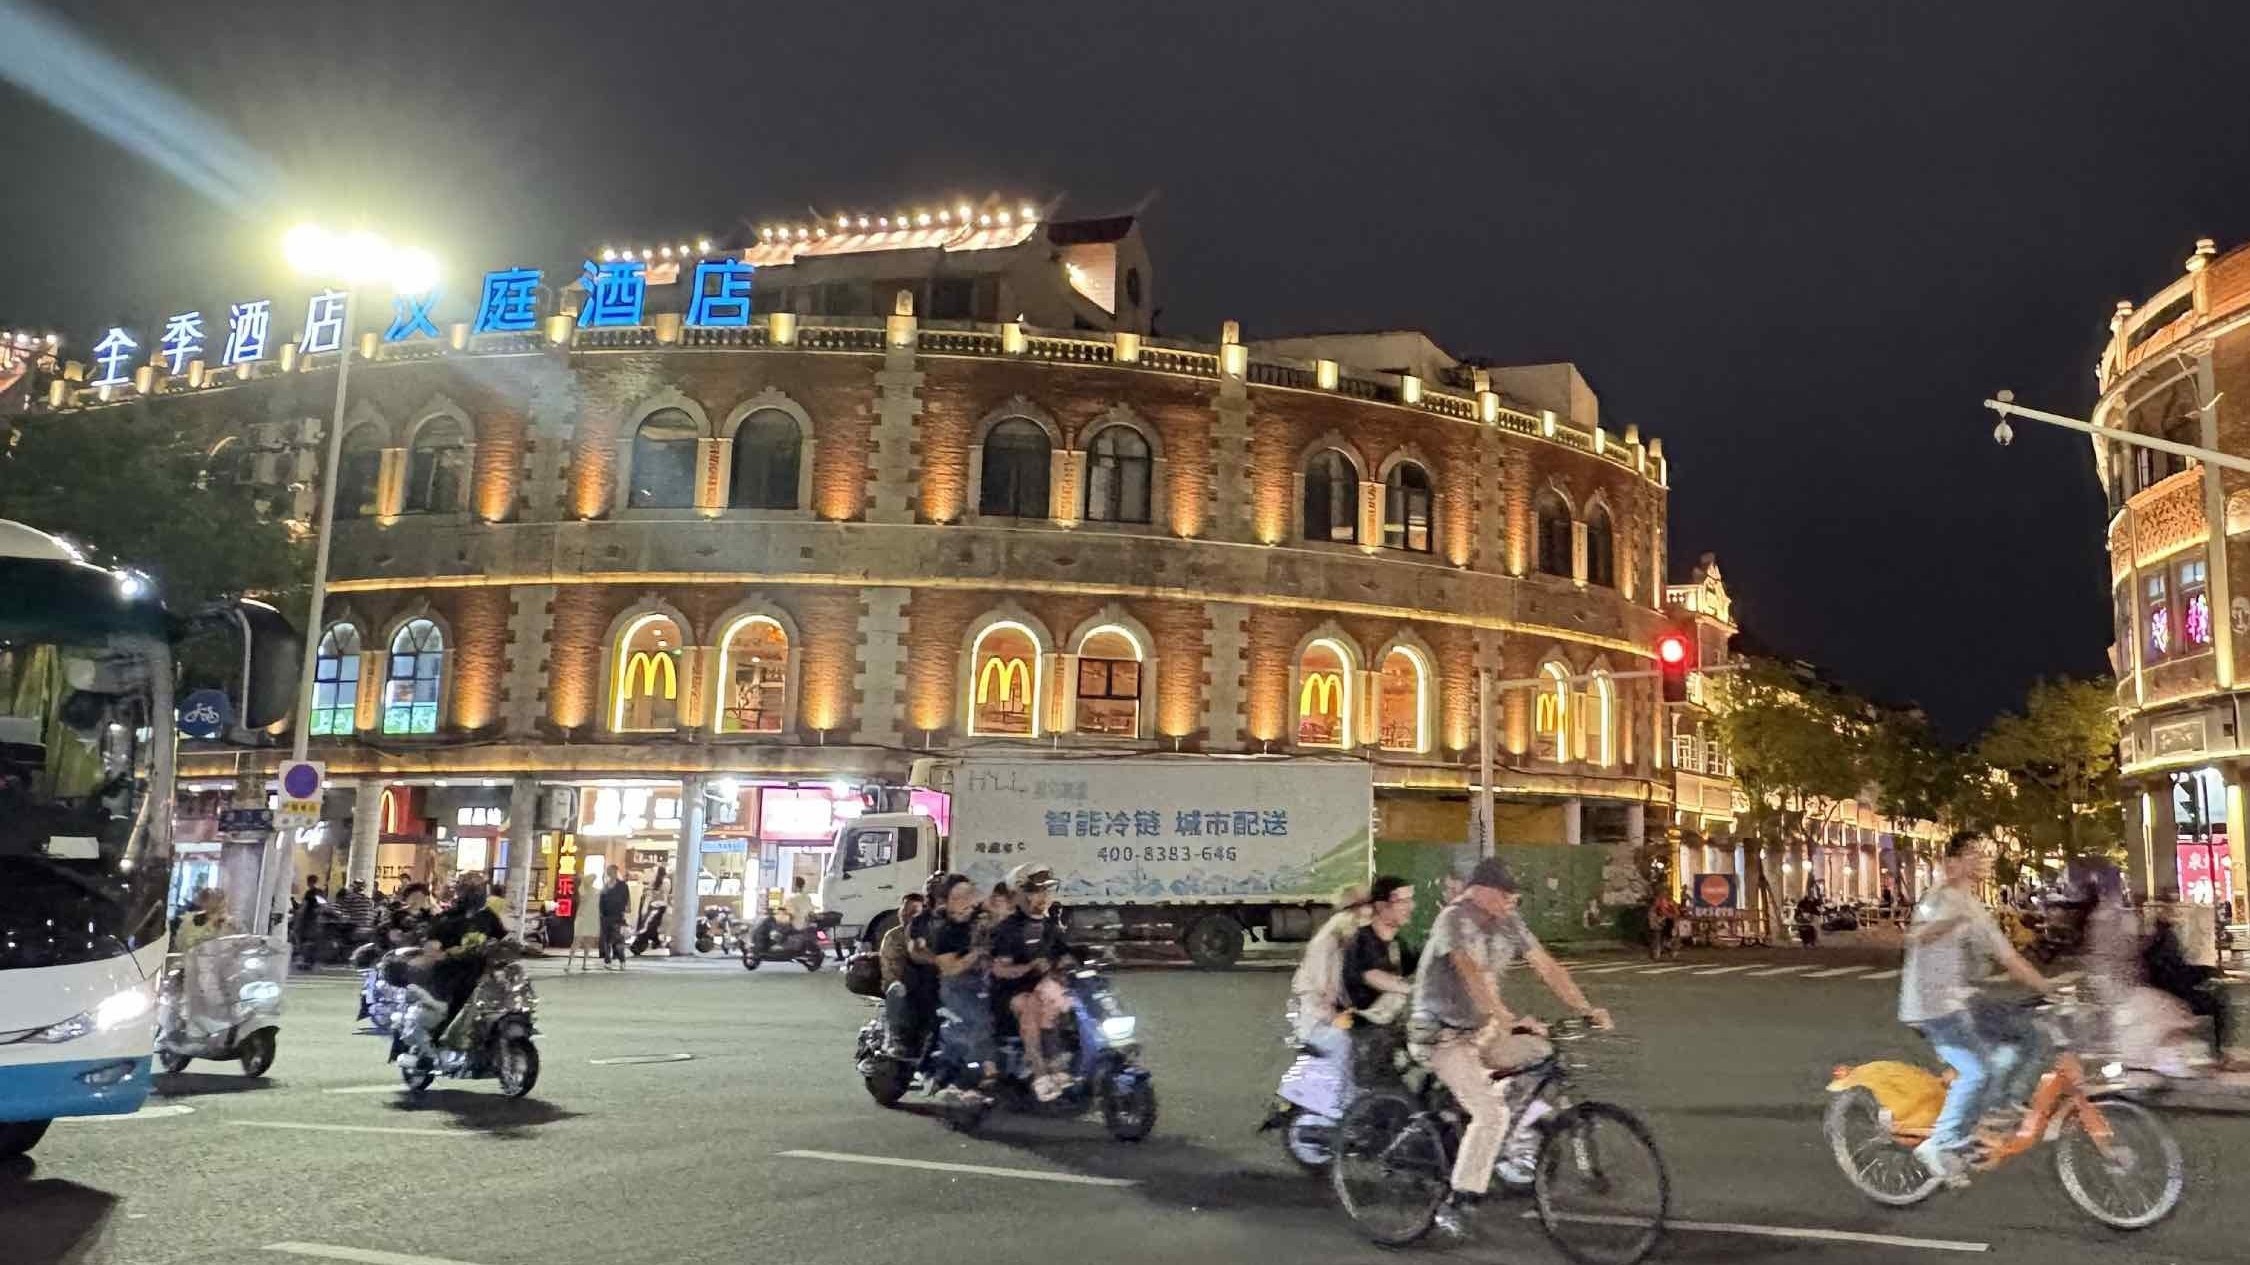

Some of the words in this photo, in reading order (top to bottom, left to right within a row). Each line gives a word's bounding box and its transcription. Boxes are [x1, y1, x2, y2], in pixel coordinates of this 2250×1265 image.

[89, 288, 350, 388] 全季酒店
[384, 257, 756, 342] 汉庭酒店
[1044, 810, 1161, 837] 智能冷链
[1174, 810, 1288, 837] 城市配送
